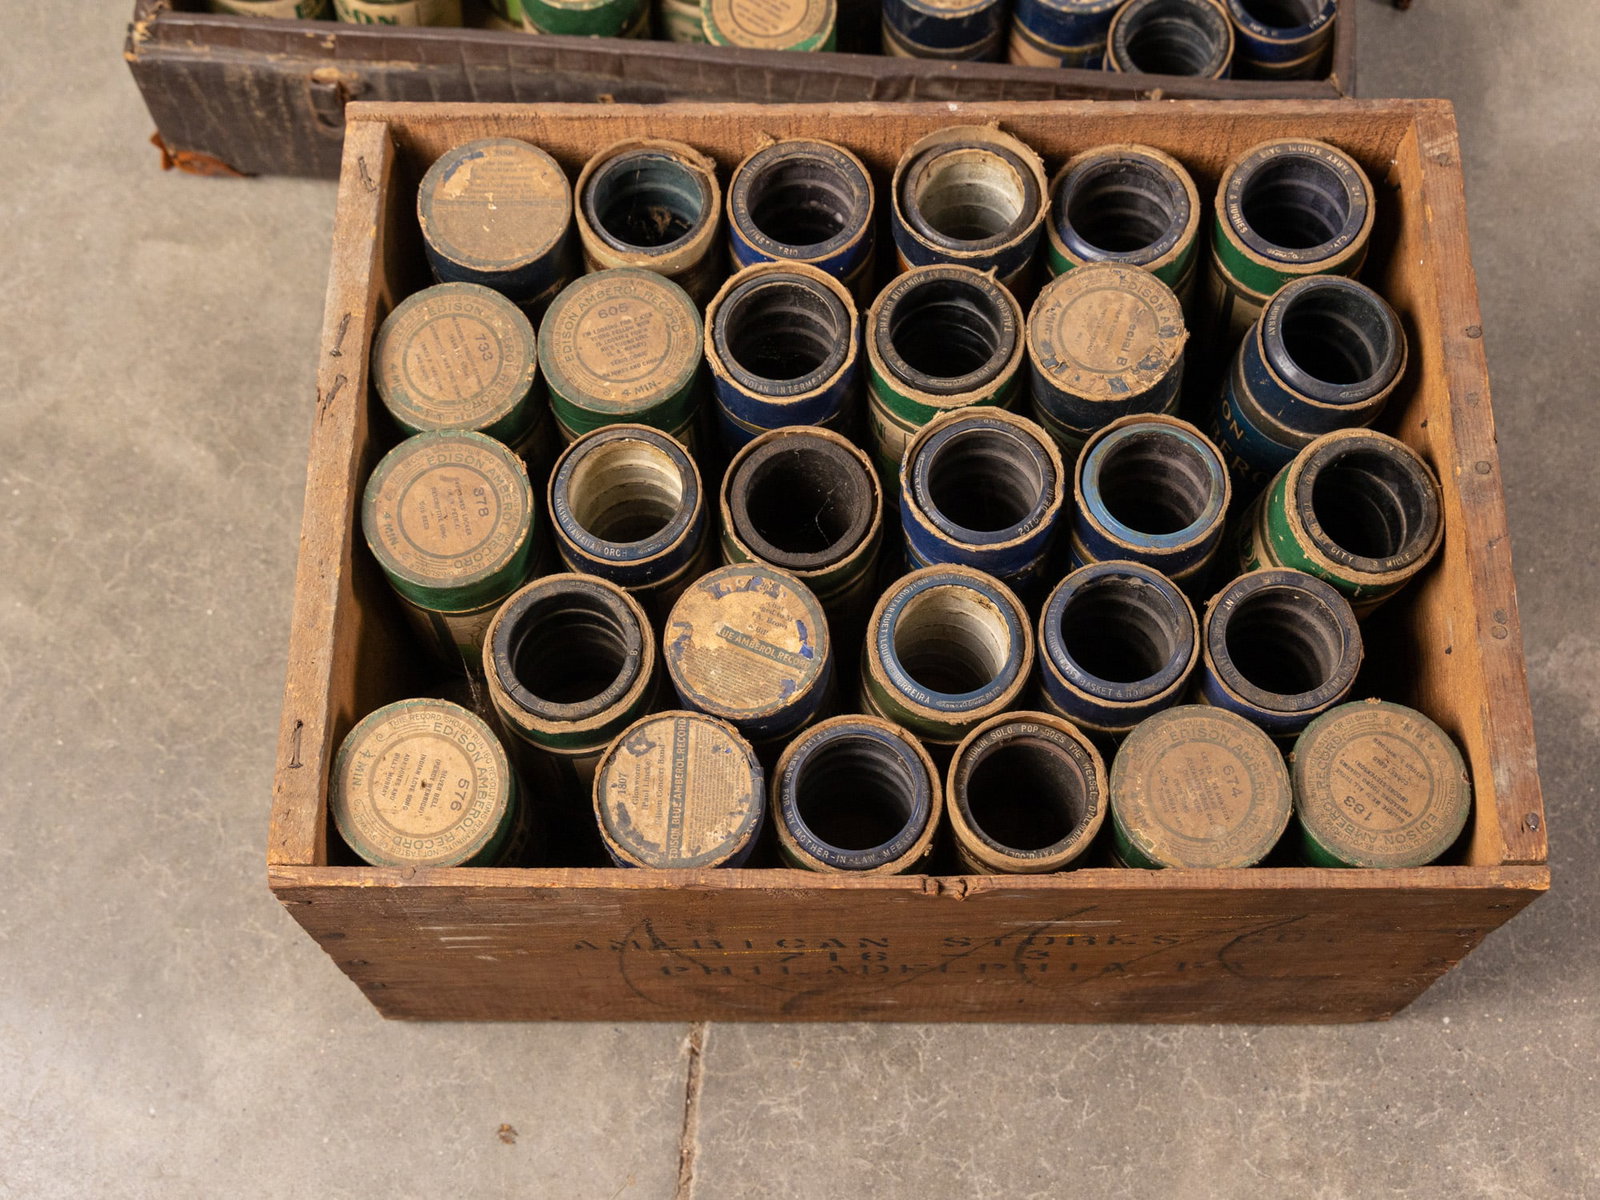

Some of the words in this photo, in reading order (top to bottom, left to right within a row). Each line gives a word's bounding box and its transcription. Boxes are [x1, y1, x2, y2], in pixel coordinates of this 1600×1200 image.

[1229, 204, 1248, 234] HUGHES
[779, 246, 798, 256] TRIO
[890, 275, 925, 300] PUMPKIN
[1118, 280, 1166, 312] EDISON
[428, 302, 483, 316] EDISON
[599, 303, 629, 319] 605
[563, 313, 579, 362] EDISON
[577, 286, 637, 311] AMBEROL
[644, 291, 681, 333] RECORD
[475, 335, 493, 361] 733
[1116, 356, 1128, 366] B
[635, 380, 662, 395] MIN.
[741, 377, 770, 393] INDIAN
[427, 453, 485, 468] EDISON
[473, 487, 489, 518] 878
[487, 468, 513, 530] AMBEROL
[454, 532, 505, 569] RECORD
[1331, 547, 1354, 563] CITY
[1224, 591, 1244, 611] WANT
[736, 635, 776, 658] AMBEROL
[777, 652, 810, 668] RECORD
[1078, 676, 1113, 696] BASKET
[444, 716, 473, 735] SHOULD
[679, 718, 687, 754] RECORD
[432, 722, 483, 763] EDISON
[967, 739, 991, 761] VIOLIN
[1021, 724, 1039, 732] POP
[1045, 729, 1066, 743] GOES
[1068, 743, 1084, 759] THE
[414, 753, 426, 776] INDIAN
[785, 754, 800, 783] READY
[1316, 736, 1343, 791] RECORD
[382, 769, 395, 797] MURRAY
[408, 777, 418, 792] LOVE
[438, 770, 448, 791] SILVER
[617, 772, 627, 795] 1807
[657, 765, 665, 795] Concert
[676, 756, 685, 801] AMBEROL
[1222, 765, 1243, 798] 674
[390, 787, 399, 801] AND
[402, 793, 412, 811] SONG
[431, 792, 440, 809] BELL
[450, 777, 469, 812] 576
[456, 766, 490, 833] AMBEROL
[782, 789, 791, 807] FOR
[674, 801, 682, 825] BLUE
[785, 810, 796, 825] MY
[1321, 794, 1378, 843] AMBEROL
[392, 832, 457, 850] RECORD
[1384, 813, 1439, 846] EDISON
[668, 828, 680, 859] EDISON
[882, 827, 918, 858] MEEKER
[574, 936, 891, 951] AMERICAN
